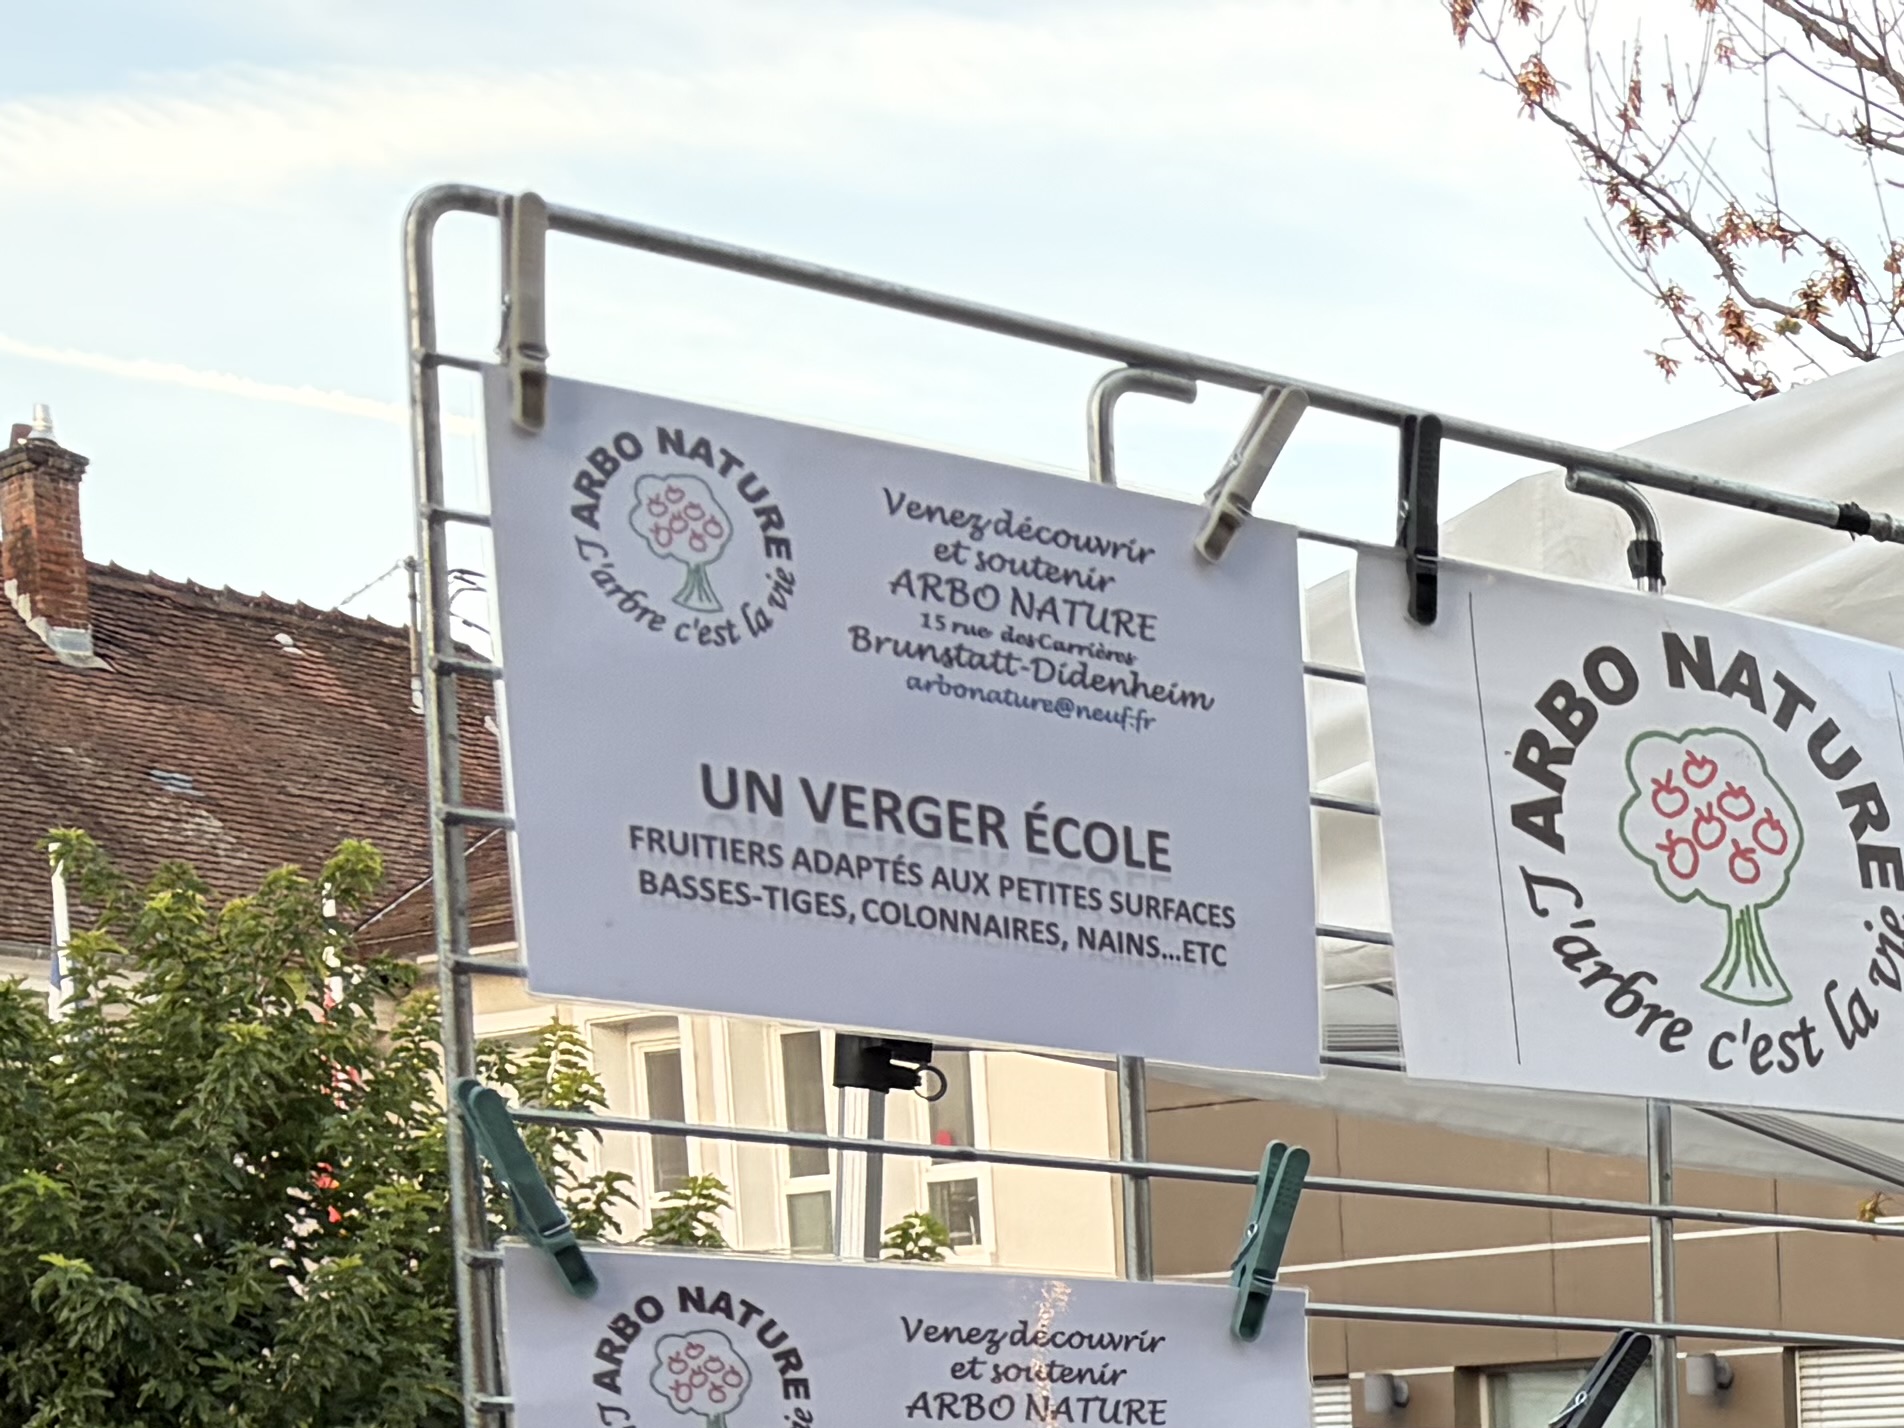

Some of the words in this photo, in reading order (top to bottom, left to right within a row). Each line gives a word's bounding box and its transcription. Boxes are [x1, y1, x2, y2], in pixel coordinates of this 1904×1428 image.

[882, 487, 992, 536] Venez
[993, 508, 1156, 565] découvrir
[934, 540, 971, 566] et
[974, 550, 1116, 593] soutenir
[889, 568, 1001, 612] ARBO
[1010, 586, 1158, 643] NATURE
[921, 612, 946, 632] 15
[951, 621, 993, 639] rue
[1000, 626, 1036, 649] des
[1035, 633, 1137, 667] Carrières
[848, 625, 1216, 711] Brunstatt-Didenheim
[905, 675, 1157, 734] arbonature@neuf.fr
[1510, 644, 1641, 855] ARBO
[701, 763, 784, 818] UN
[799, 777, 1009, 850] VERGER
[1024, 811, 1172, 873] ÉCOLE
[629, 825, 784, 869] FRUITIERS
[791, 847, 924, 888] ADAPTÉS
[930, 866, 991, 897] AUX
[999, 874, 1103, 912] PETITES
[1109, 890, 1236, 930] SURFACES
[639, 869, 856, 925] BASSES-TIGES,
[861, 898, 1069, 952] COLONNAIRES,
[1077, 925, 1227, 968] NAINS...ETC
[1519, 863, 1694, 1053] L'arbre
[1708, 1016, 1824, 1075] c'est
[1825, 978, 1879, 1051] la
